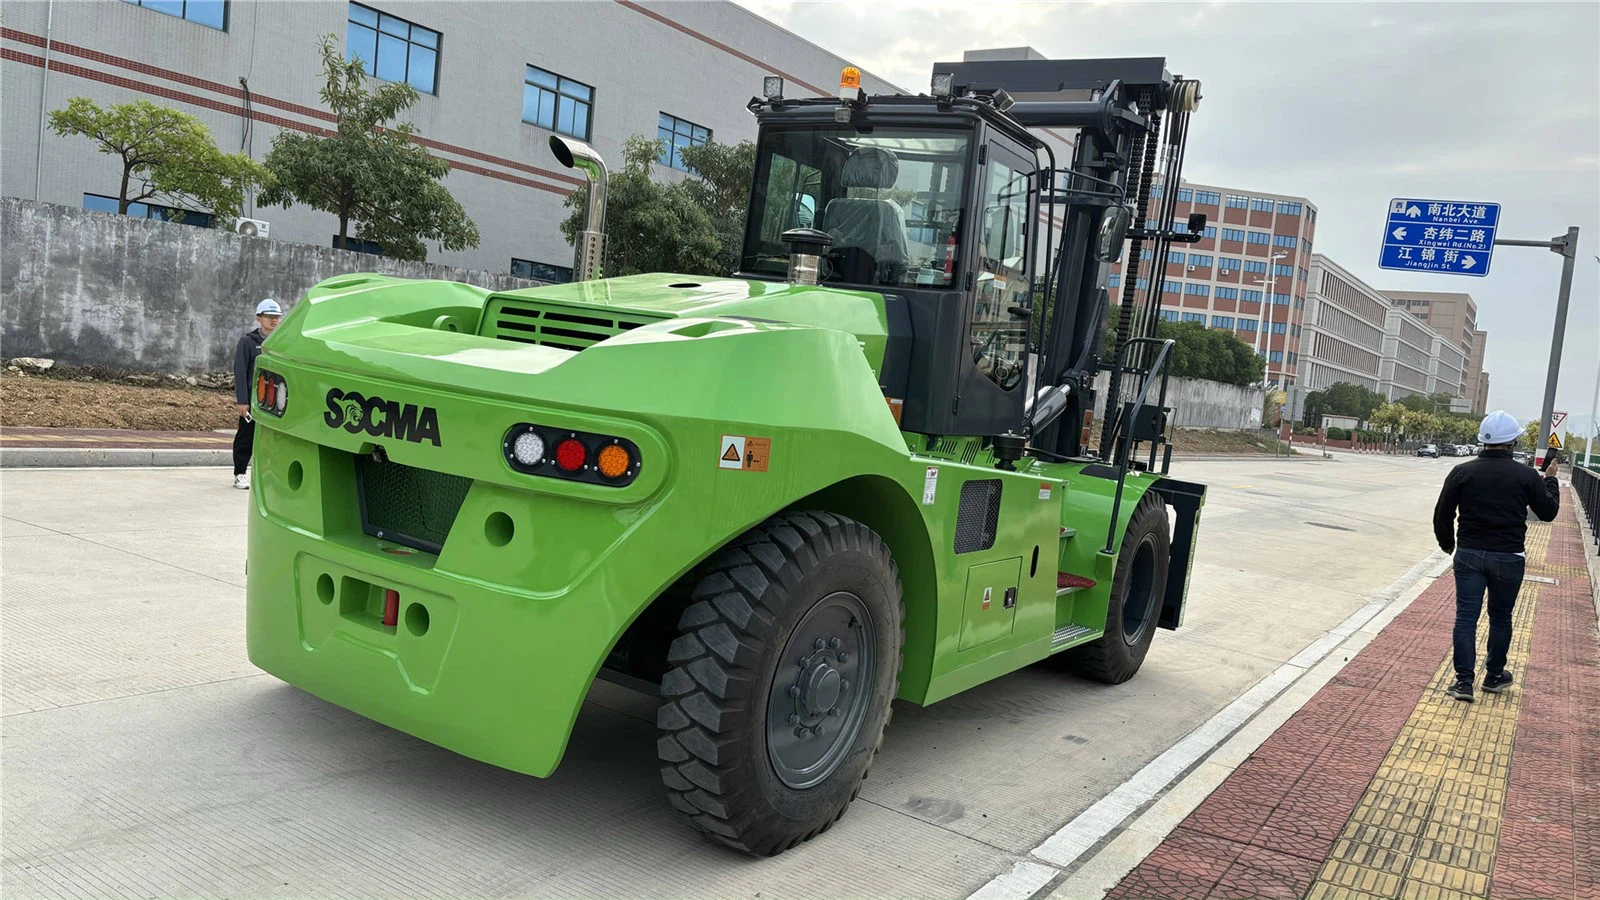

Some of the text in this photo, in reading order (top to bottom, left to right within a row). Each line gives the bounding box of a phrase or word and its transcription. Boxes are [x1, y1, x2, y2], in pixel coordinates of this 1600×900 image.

[1428, 204, 1486, 218] 南北大道
[1424, 227, 1485, 242] 杏纬二路
[1398, 247, 1459, 262] 江锦街
[1406, 260, 1438, 268] Jiangjin
[324, 388, 442, 447] SOCMA
